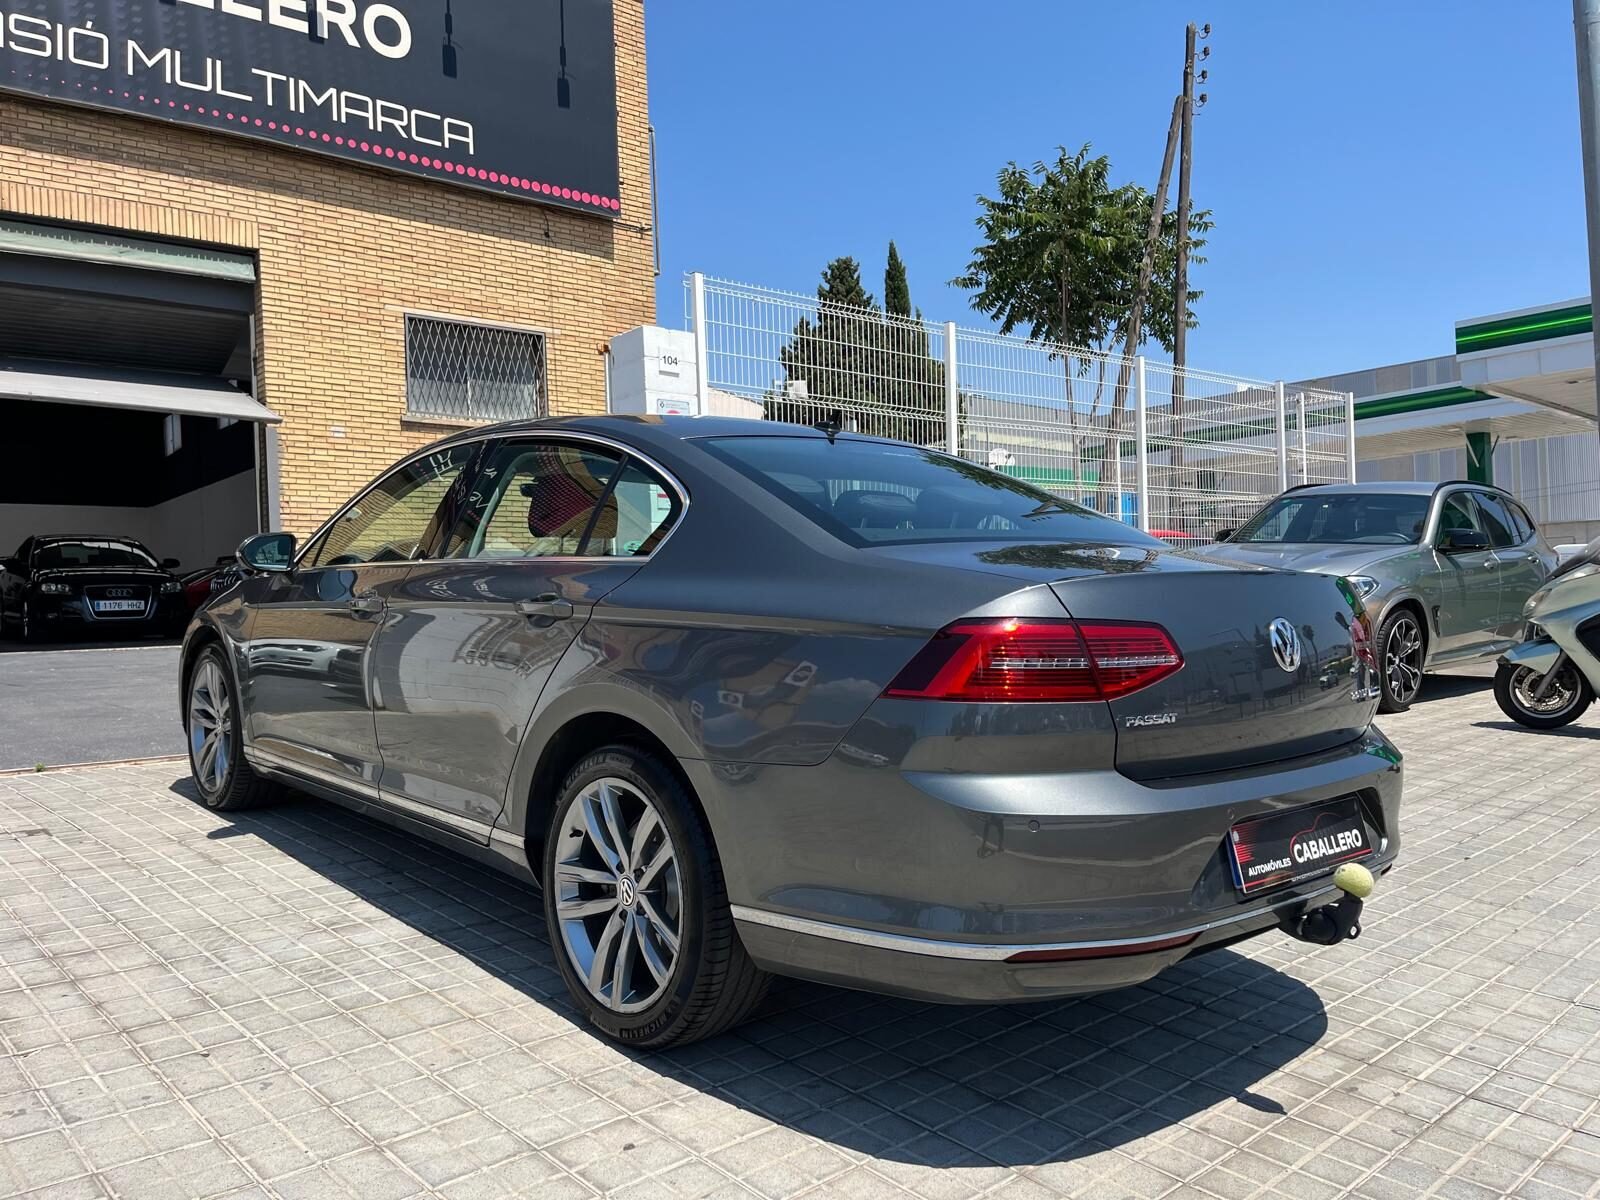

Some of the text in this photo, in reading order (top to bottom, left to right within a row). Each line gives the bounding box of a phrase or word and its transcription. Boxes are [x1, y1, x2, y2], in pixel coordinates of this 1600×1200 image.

[0, 11, 475, 155] SIÓ MULTIMARCA
[663, 355, 678, 366] 104
[1125, 712, 1178, 727] PASSAT
[1293, 828, 1363, 864] CABALLERO
